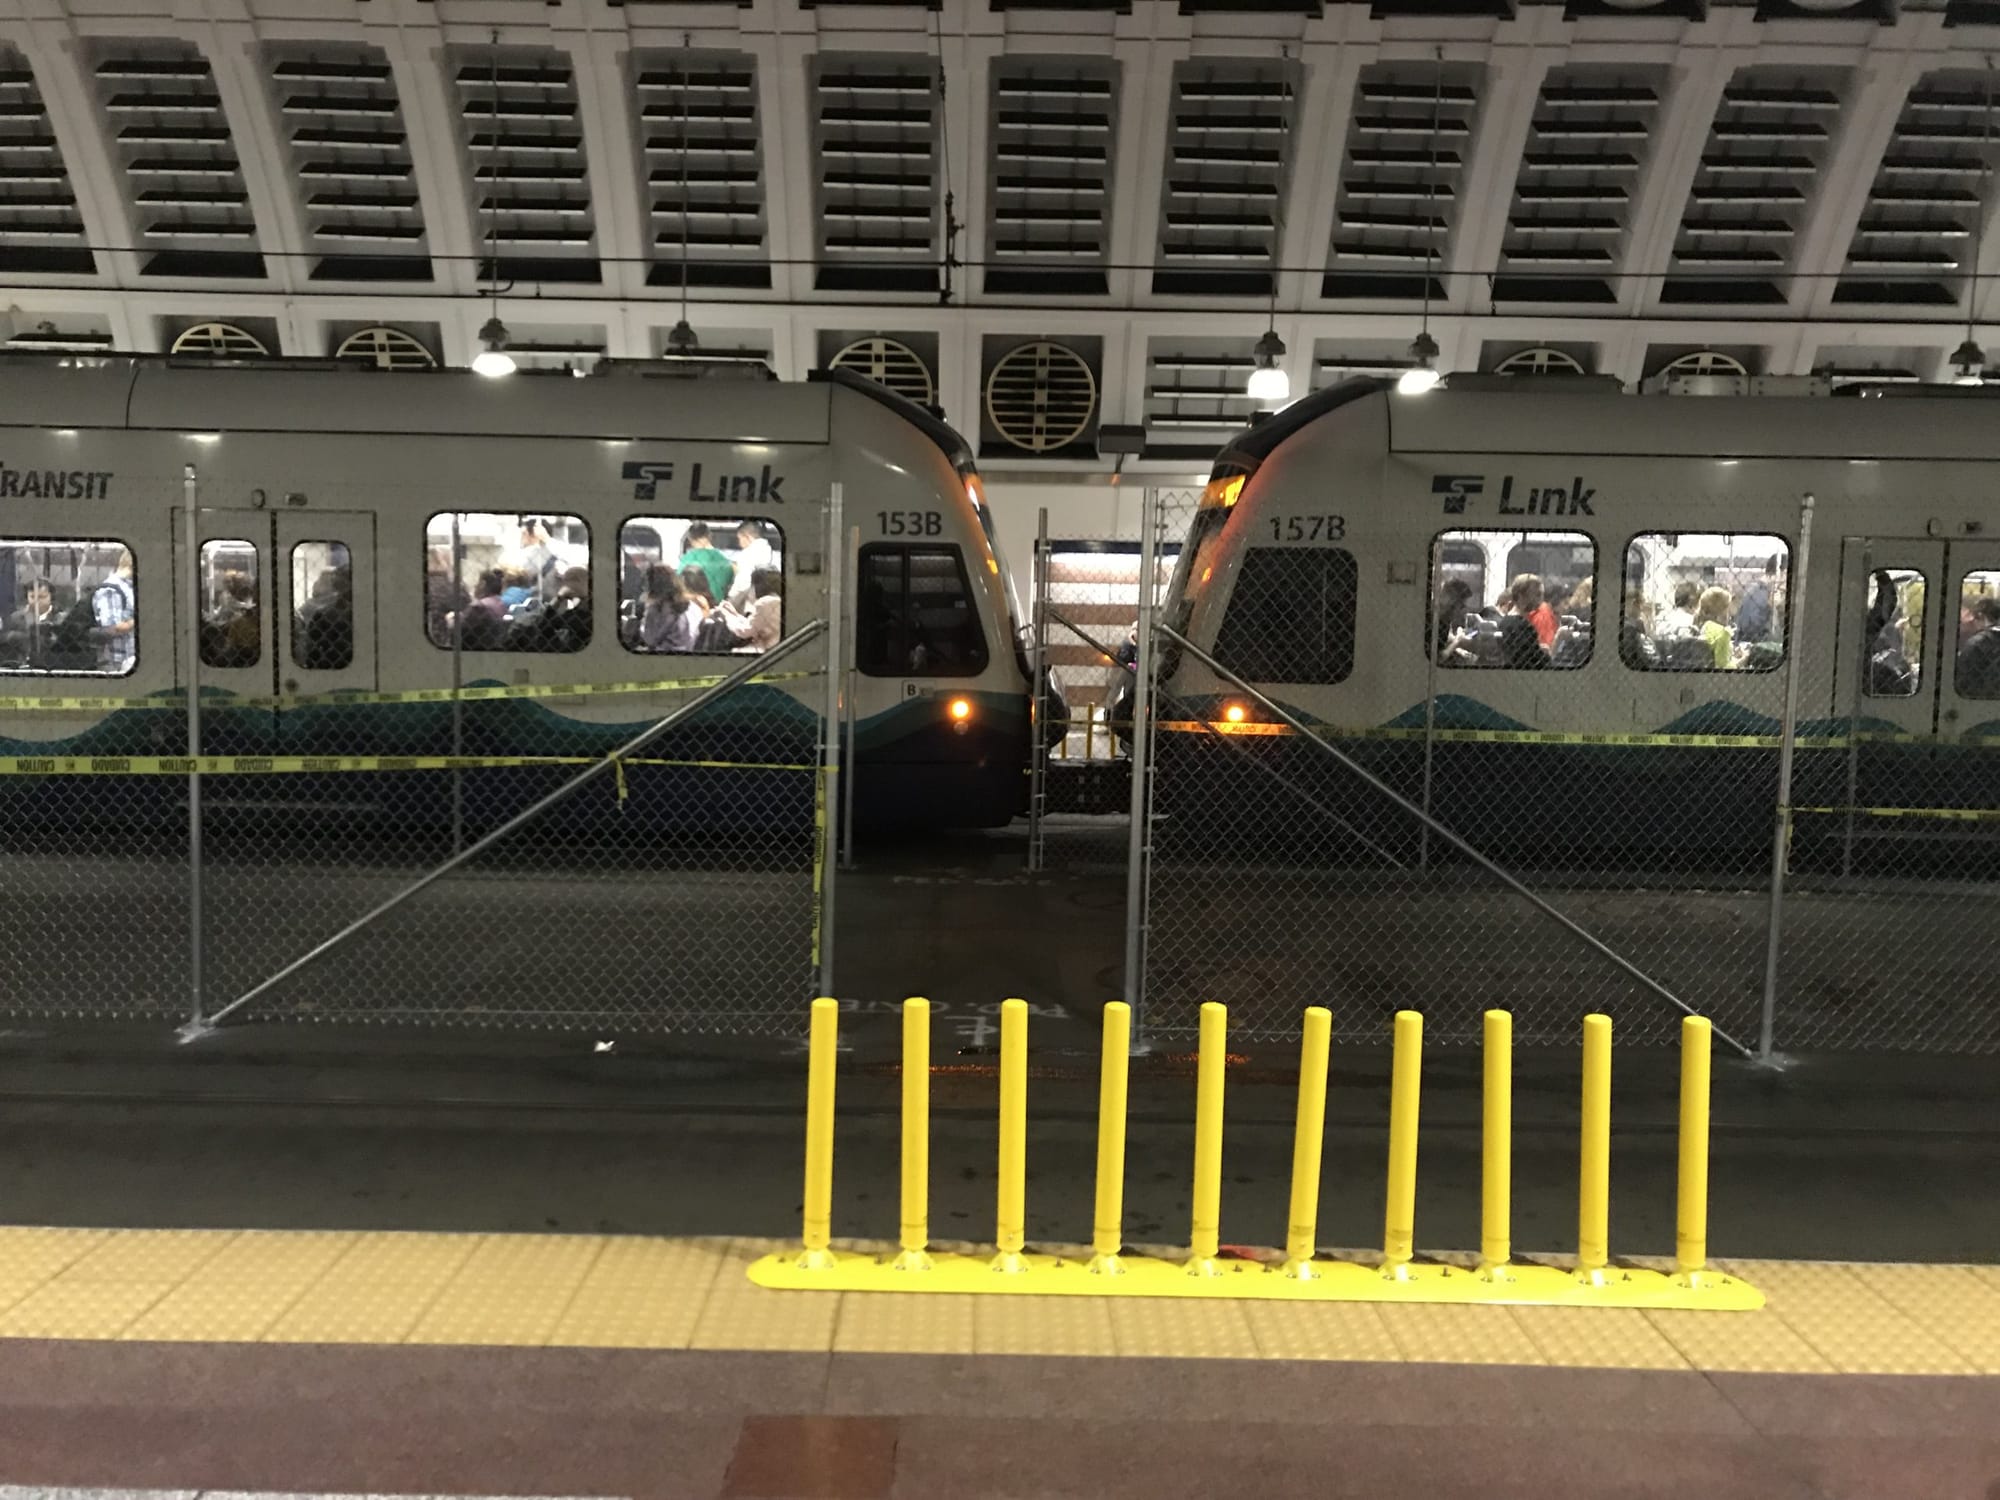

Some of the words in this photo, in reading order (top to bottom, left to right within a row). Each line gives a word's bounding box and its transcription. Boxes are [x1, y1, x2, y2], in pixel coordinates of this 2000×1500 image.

[0, 464, 114, 500] RANSIT
[689, 463, 785, 504] Link
[1498, 476, 1596, 516] Link
[877, 511, 942, 536] 153B
[1270, 515, 1346, 541] 157B
[907, 684, 916, 696] B
[17, 759, 55, 772] CAUTION
[91, 759, 131, 772] CUIDADO
[159, 760, 197, 772] CAUTION
